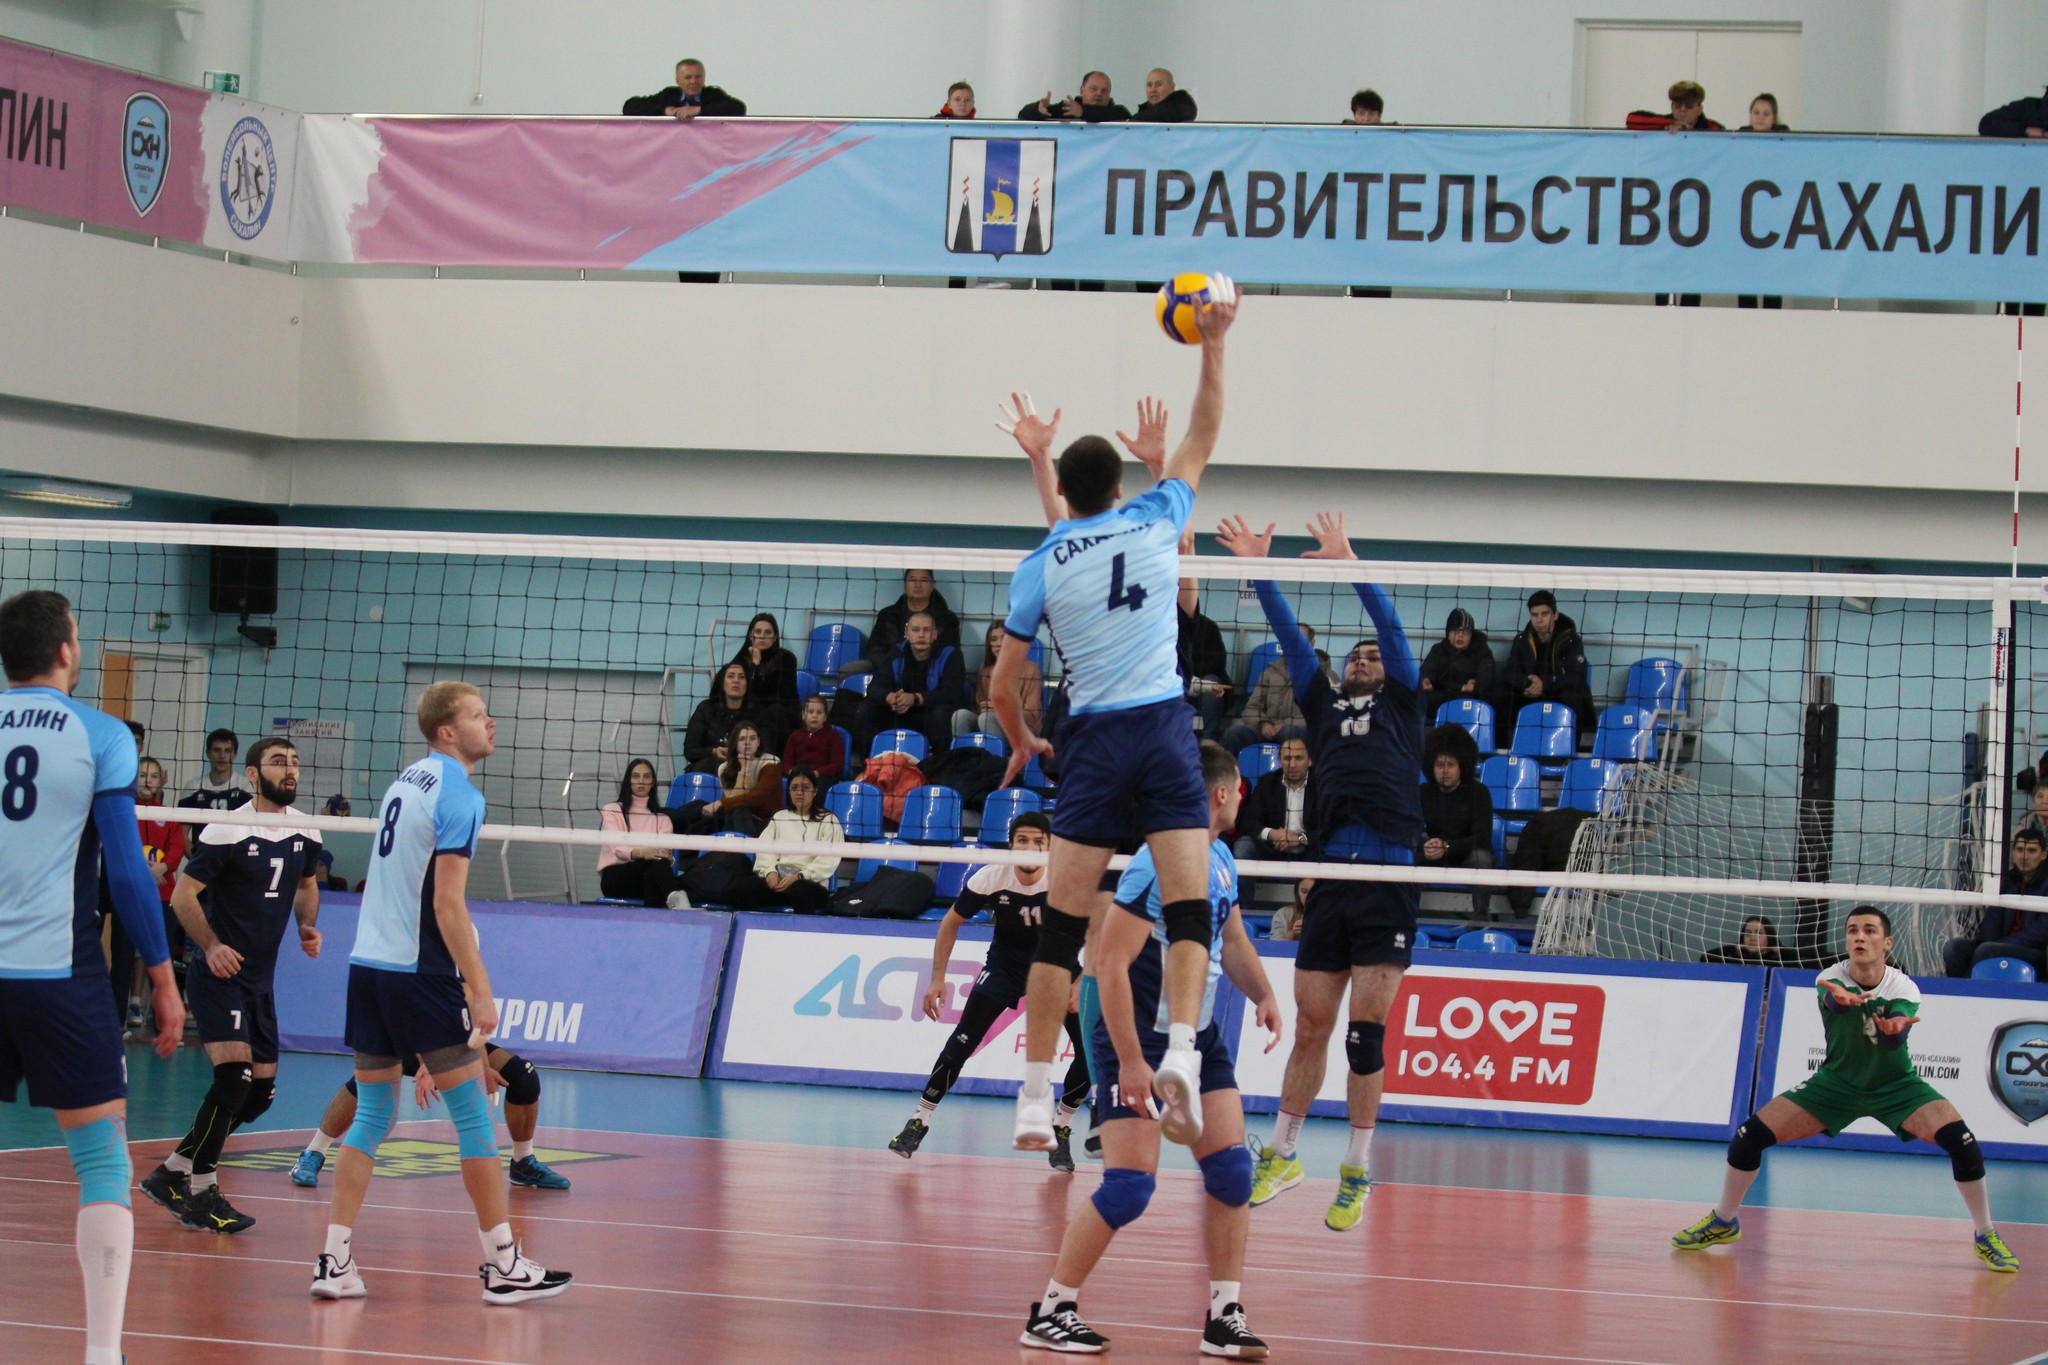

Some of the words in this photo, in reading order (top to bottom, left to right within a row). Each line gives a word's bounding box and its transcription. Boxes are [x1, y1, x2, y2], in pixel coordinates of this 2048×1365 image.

[229, 213, 262, 239] САХАЛИН
[1104, 168, 1711, 248] ПРАВИТЕЛЬСТВО
[1739, 178, 2042, 257] САХАЛИ
[1108, 551, 1149, 613] 4
[0, 708, 69, 733] АЛИН
[2, 744, 40, 822] 8
[378, 796, 403, 859] 8
[266, 857, 285, 891] 7
[1019, 905, 1043, 927] 11
[230, 1009, 242, 1030] 7
[461, 1007, 471, 1031] 8
[1403, 993, 1578, 1046] LOVE
[1397, 1049, 1496, 1081] 104.4
[1509, 1056, 1571, 1086] FM
